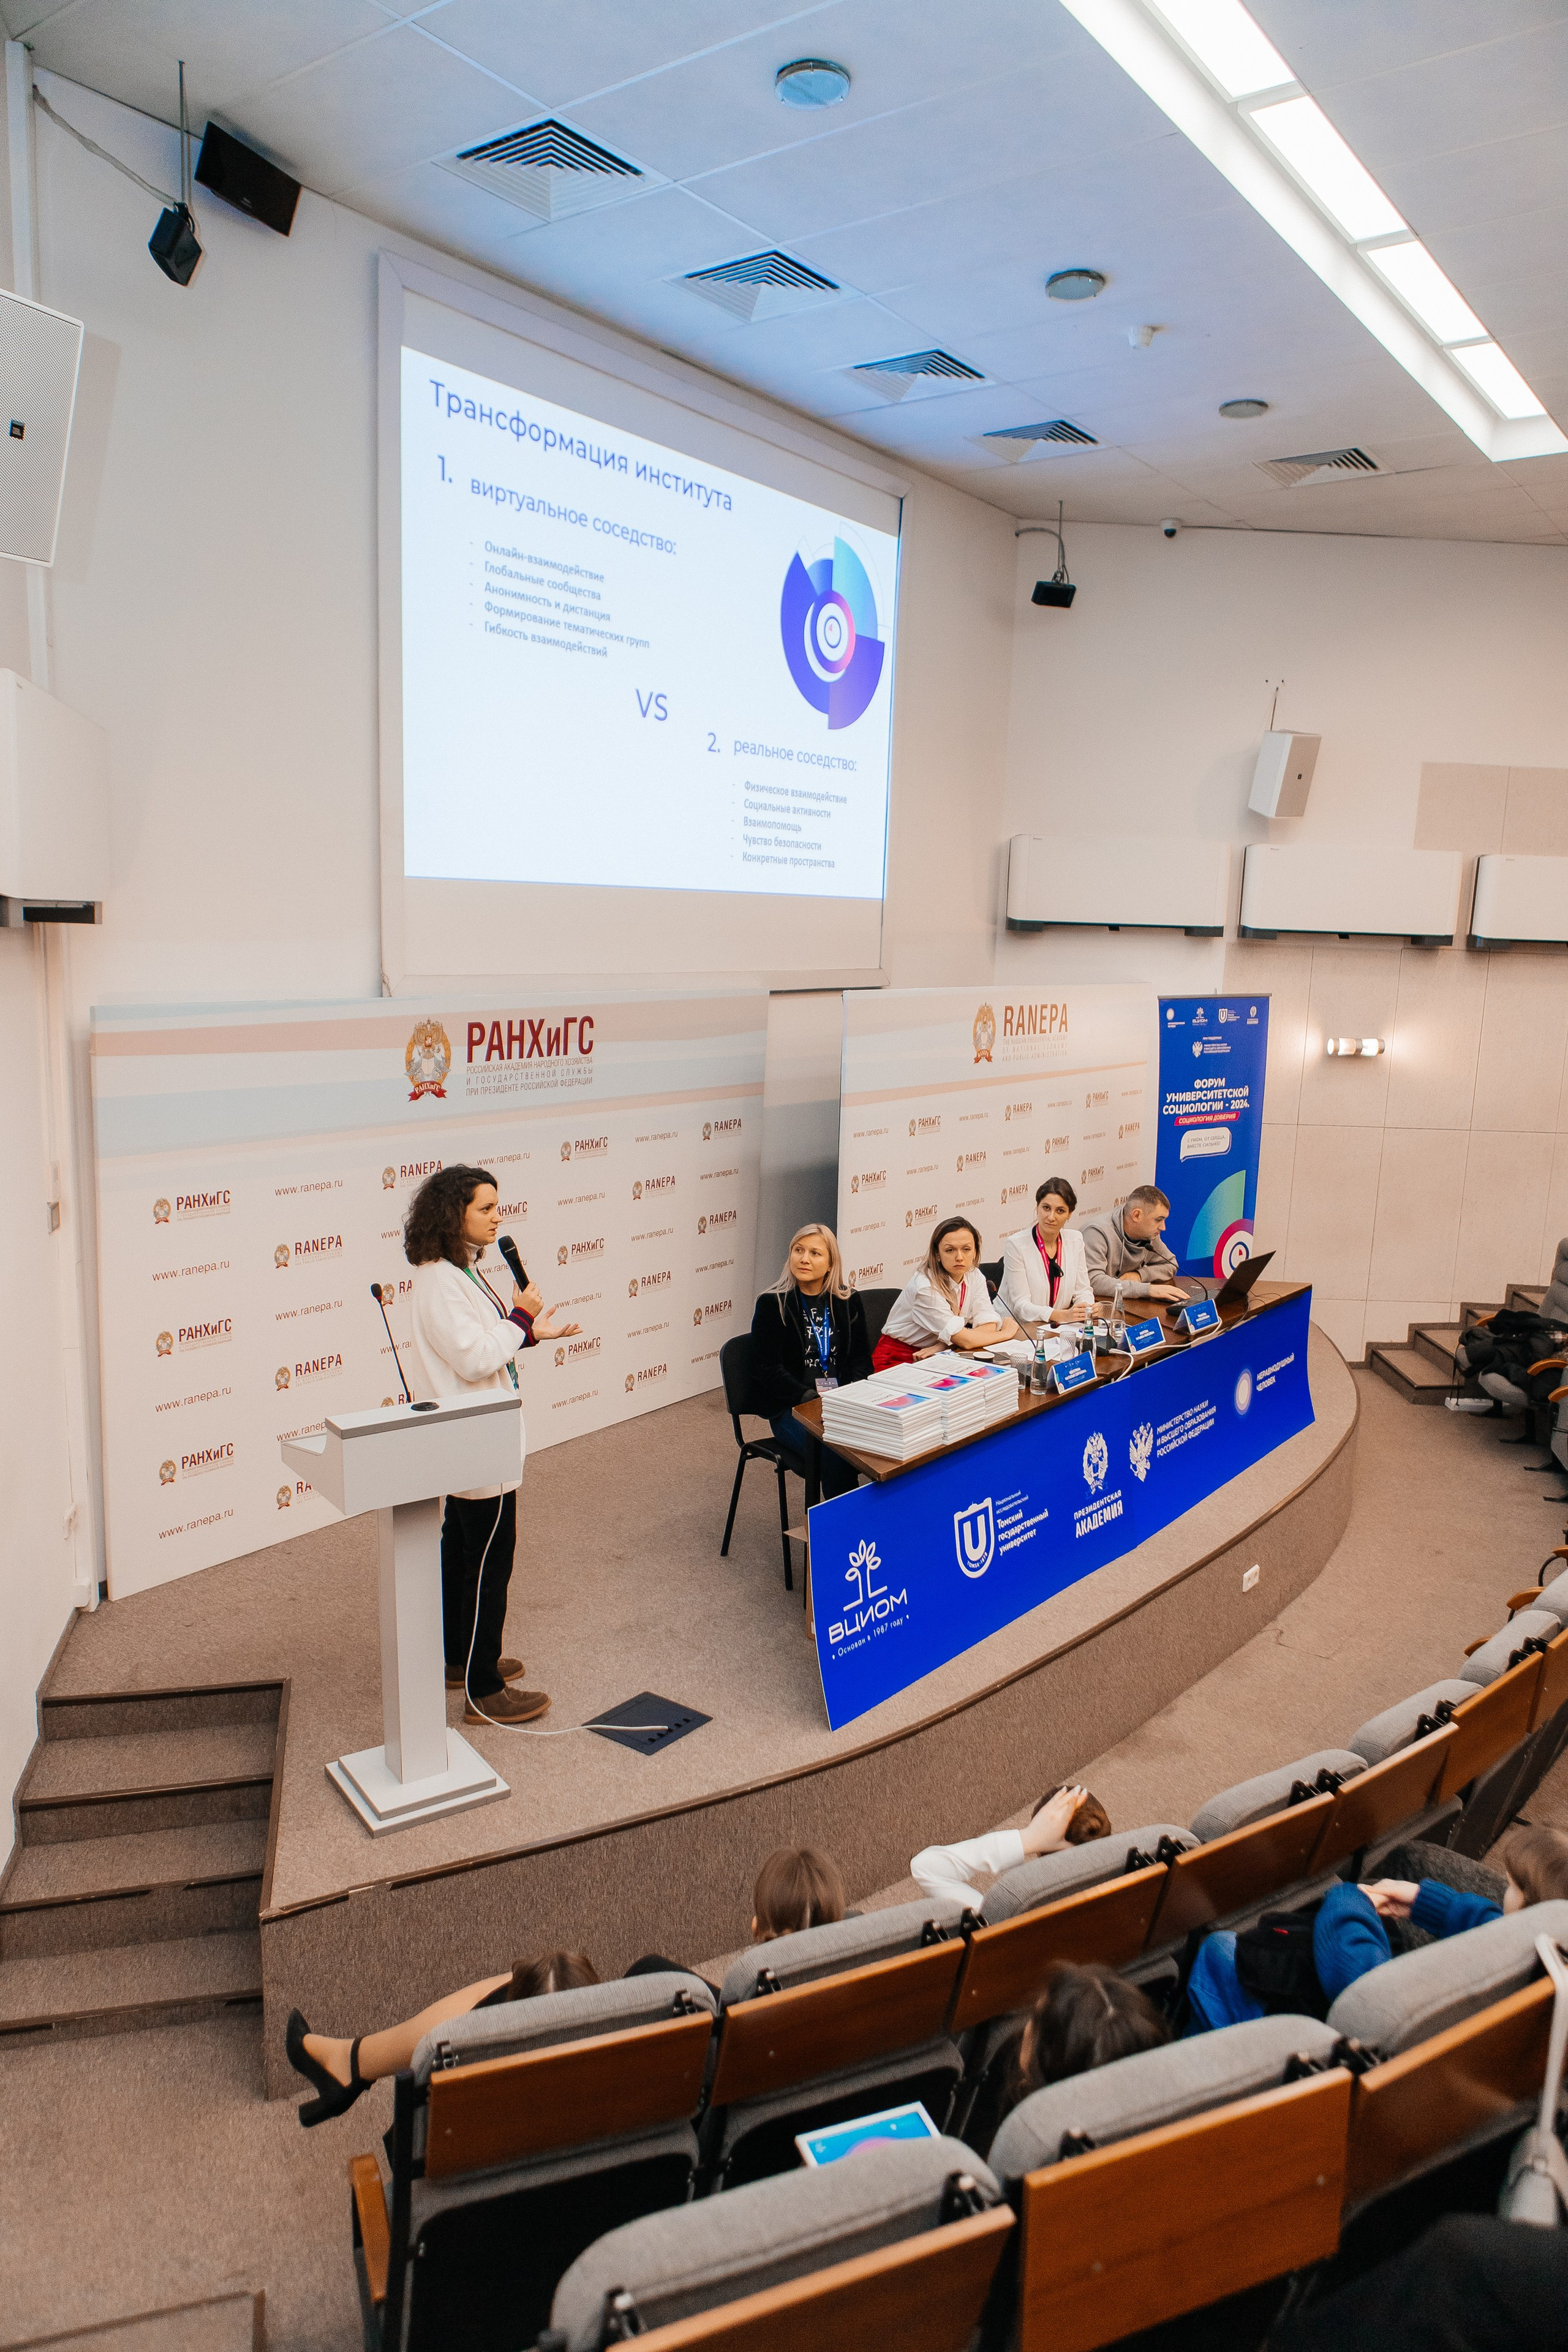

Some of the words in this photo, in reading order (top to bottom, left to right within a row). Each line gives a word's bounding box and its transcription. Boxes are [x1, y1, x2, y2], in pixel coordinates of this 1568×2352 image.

[430, 379, 628, 473] Трансформация
[635, 461, 733, 510] института
[438, 455, 453, 483] 1.
[471, 478, 588, 526] виртуальное
[593, 518, 676, 555] соседство:
[484, 540, 605, 582] Онлайн-взаимодействие
[484, 562, 545, 587] Глобальные
[547, 578, 601, 601] сообщества
[484, 582, 552, 608] Анонимность
[554, 600, 560, 609] и
[563, 602, 611, 622] дистанция
[484, 601, 560, 627] Формирование
[563, 620, 624, 643] тематических
[626, 635, 650, 649] групп
[484, 621, 528, 642] Гибкость
[530, 633, 608, 658] взаимодействий
[707, 732, 721, 753] 2.
[734, 739, 794, 761] реальное
[796, 749, 857, 772] соседство:
[744, 780, 789, 797] Физическое
[791, 788, 847, 805] взаимодействие
[744, 799, 790, 815] Социальные
[792, 805, 831, 819] активности
[743, 816, 802, 834] Взаимопомощь
[742, 834, 772, 848] Чувство
[774, 836, 821, 851] безопасности
[742, 851, 788, 865] Конкретные
[790, 858, 835, 869] пространства
[1003, 1003, 1068, 1036] RANEPA
[467, 1016, 594, 1063] РАНХиГС
[467, 1063, 502, 1074] РОССИЙСКАЯ
[504, 1061, 533, 1071] АКАДЕМИЯ
[534, 1058, 564, 1069] НАРОДНОГО
[564, 1056, 593, 1066] ХОЗЯЙСТВА
[475, 1069, 557, 1084] ГОСУДАРСТВЕННОЙ
[560, 1066, 593, 1076] СЛУЖБЫ
[1194, 1077, 1226, 1089] ФОРУМ
[415, 1082, 441, 1095] РАНХиГС
[466, 1088, 478, 1096] ПРИ
[480, 1084, 519, 1095] ПРЕЗИДЕНТЕ
[520, 1079, 558, 1091] РОССИЙСКОЙ
[560, 1076, 593, 1087] ФЕДЕРАЦИИ
[1166, 1085, 1249, 1103] УНИВЕРСИТЕТСКОЙ
[1092, 1090, 1109, 1101] РАНХиГС
[1012, 1102, 1033, 1114] RANEPA
[1163, 1101, 1224, 1115] СОЦИОЛОГИИ
[1230, 1099, 1250, 1110] 2024.
[714, 1118, 742, 1132] RANEPA
[919, 1115, 941, 1128] РАНХиГС
[959, 1112, 989, 1121] www.ranepa.ru
[1178, 1115, 1213, 1125] СОЦИОЛОГИЯ
[1213, 1113, 1236, 1122] ДОВЕРИЯ
[853, 1127, 889, 1139] www.ranepa.ru
[1125, 1121, 1140, 1133] RANEPA
[575, 1136, 608, 1152] РАНХиГС
[635, 1130, 679, 1143] www.ranepa.ru
[1052, 1135, 1069, 1147] РАНХиГС
[477, 1151, 530, 1166] www.ranepa.ru
[965, 1151, 986, 1164] RANEPA
[400, 1159, 443, 1178] RANEPA
[699, 1167, 739, 1181] www.ranepa.ru
[862, 1170, 886, 1185] РАНХиГС
[906, 1164, 939, 1175] www.ranepa.ru
[1088, 1166, 1104, 1177] РАНХиГС
[274, 1178, 344, 1196] www.ranepa.ru
[645, 1175, 676, 1191] RANEPA
[1009, 1183, 1028, 1196] RANEPA
[176, 1189, 230, 1211] РАНХиГС
[557, 1191, 605, 1207] www.ranepa.ru
[956, 1197, 985, 1208] www.ranepa.ru
[497, 1201, 528, 1217] АНХиГС
[709, 1210, 737, 1226] RANEPA
[915, 1204, 937, 1219] РАНХиГС
[631, 1227, 674, 1242] www.ranepa.ru
[850, 1221, 886, 1234] www.ranepa.ru
[295, 1234, 343, 1256] RANEPA
[571, 1237, 605, 1256] РАНХиГС
[153, 1259, 230, 1281] www.ranepa.ru
[695, 1258, 734, 1274] www.ranepa.ru
[859, 1262, 883, 1279] РАНХиГС
[641, 1270, 671, 1288] RANEPA
[554, 1291, 601, 1309] www.ranepa.ru
[704, 1299, 732, 1316] RANEPA
[275, 1300, 344, 1321] www.ranepa.ru
[178, 1318, 232, 1343] РАНХиГС
[627, 1321, 669, 1339] www.ranepa.ru
[568, 1336, 601, 1356] РАНХиГС
[295, 1353, 343, 1378] RANEPA
[691, 1349, 720, 1365] www.ranep
[637, 1363, 668, 1382] RANEPA
[1257, 1352, 1294, 1381] НЕРАВНОДУШНЫЙ
[1256, 1375, 1276, 1391] ЧЕЛОВЕК
[155, 1386, 232, 1413] www.ranepa.ru
[552, 1389, 598, 1410] www.ranepa.ru
[1157, 1408, 1193, 1434] МИНИСТЕРСТВО
[1194, 1400, 1208, 1414] НАУКИ
[1161, 1425, 1184, 1444] ВЫСШЕГО
[1185, 1406, 1216, 1430] ОБРАЗОВАНИЯ
[276, 1420, 326, 1442] www.ranep
[1157, 1432, 1188, 1458] РОССИЙСКОЙ
[1188, 1418, 1215, 1439] ФЕДЕРАЦИИ
[181, 1442, 234, 1470] РАНХиГС
[995, 1489, 1021, 1506] Национальный
[996, 1494, 1029, 1515] исследовательский
[1074, 1490, 1121, 1520] ПРЕЗИДЕНТСКАЯ
[159, 1508, 233, 1539] www.ranepa.ru
[997, 1509, 1023, 1529] Томский
[998, 1508, 1049, 1542] государственный
[1076, 1499, 1123, 1539] АКАДЕМИЯ
[963, 1513, 987, 1561] U
[999, 1528, 1036, 1556] университет
[829, 1588, 908, 1645] ВЦИОМ
[837, 1637, 865, 1657] Основан
[873, 1623, 888, 1638] 1987
[890, 1617, 903, 1630] году
